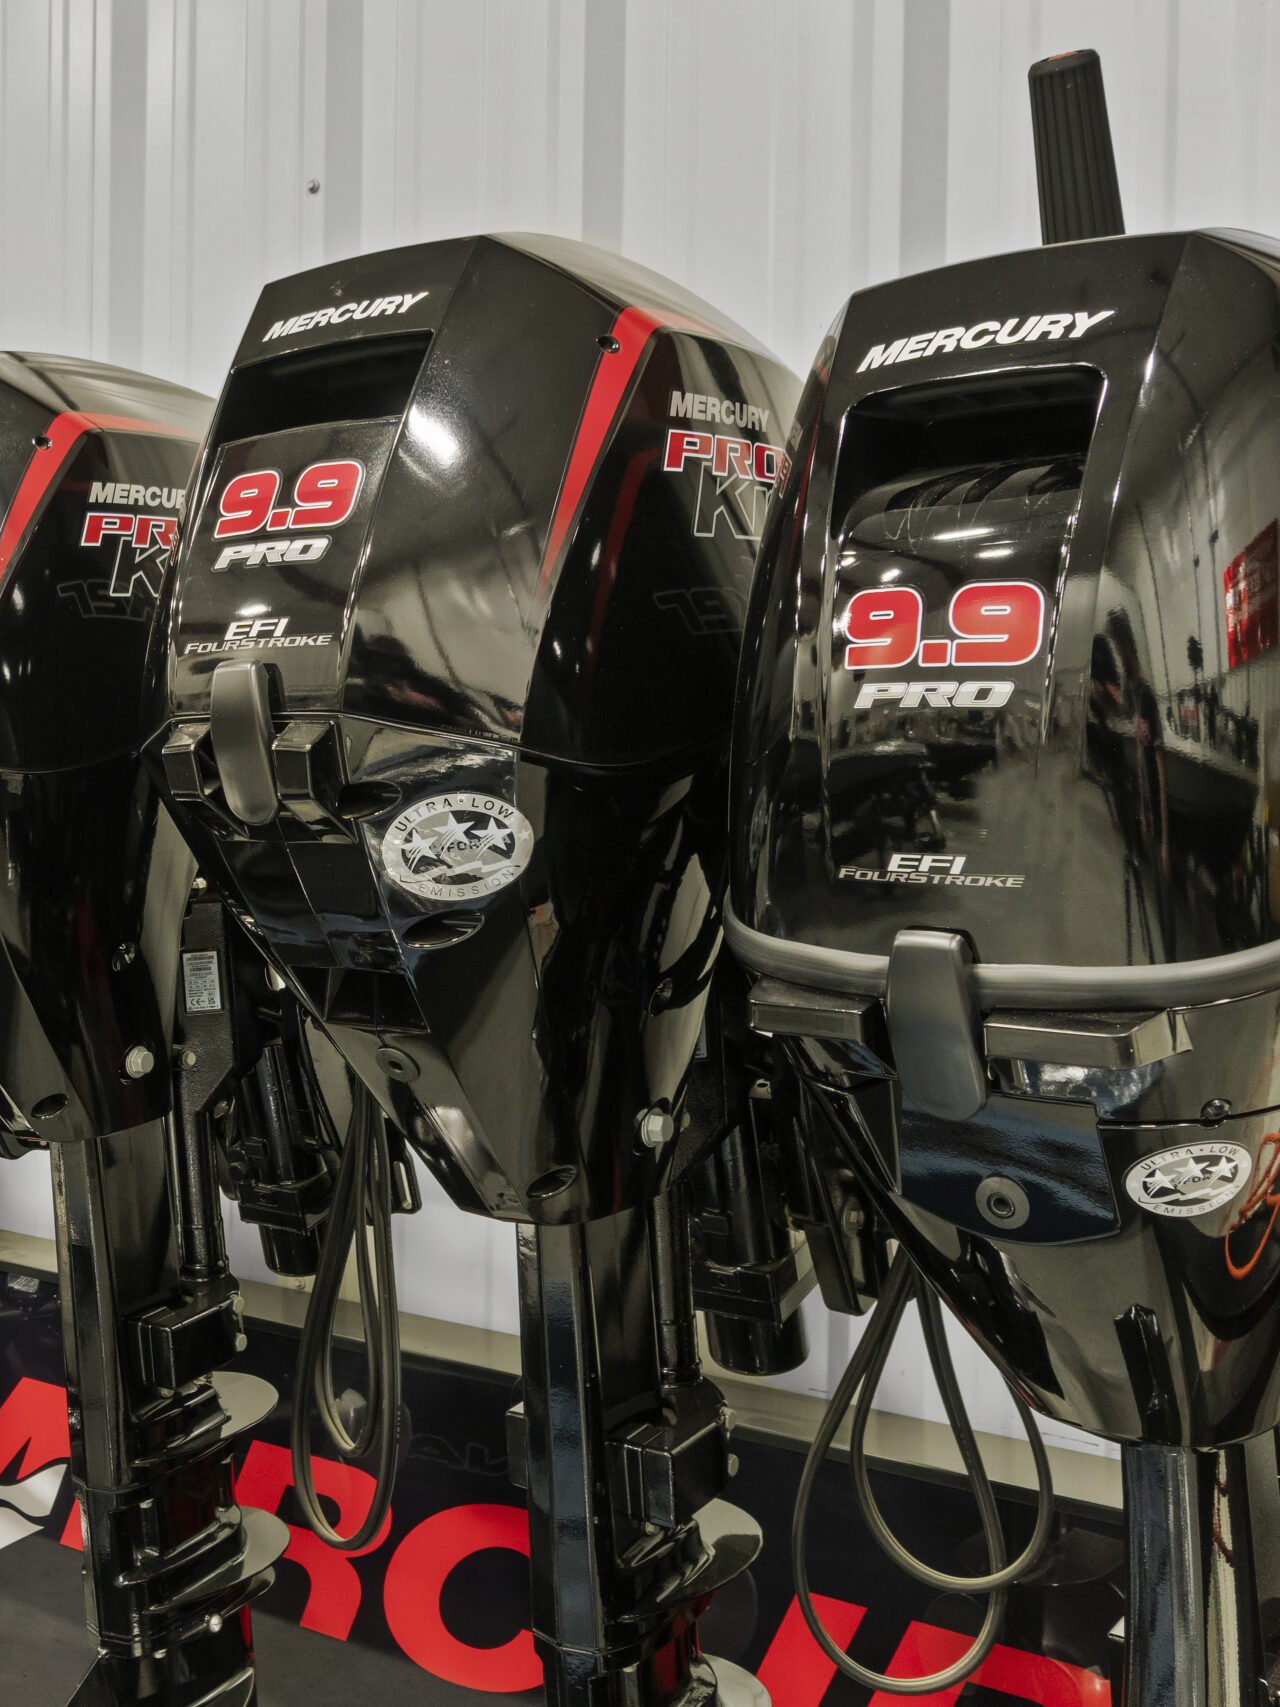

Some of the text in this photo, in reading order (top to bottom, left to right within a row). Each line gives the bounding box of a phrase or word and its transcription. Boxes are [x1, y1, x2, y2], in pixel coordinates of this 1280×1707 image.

[262, 291, 429, 342] MERCURY
[856, 310, 1115, 373] MERCURY
[670, 390, 769, 432] MERCURY
[664, 429, 788, 484] PRO
[89, 481, 186, 508] MERCUR
[214, 460, 363, 538] 9.9
[81, 512, 179, 549] PR
[215, 538, 329, 569] PRO
[225, 617, 289, 640] EFI
[844, 581, 1045, 670] 9.9
[184, 635, 332, 654] FOURSTROKE
[854, 681, 1015, 708] PRO
[395, 797, 514, 832] ULTRA LOW
[838, 867, 1025, 888] FOURSTROKE
[887, 853, 967, 875] EFI
[418, 869, 514, 898] EMISSION
[1140, 1145, 1239, 1171] ULTRA LOW
